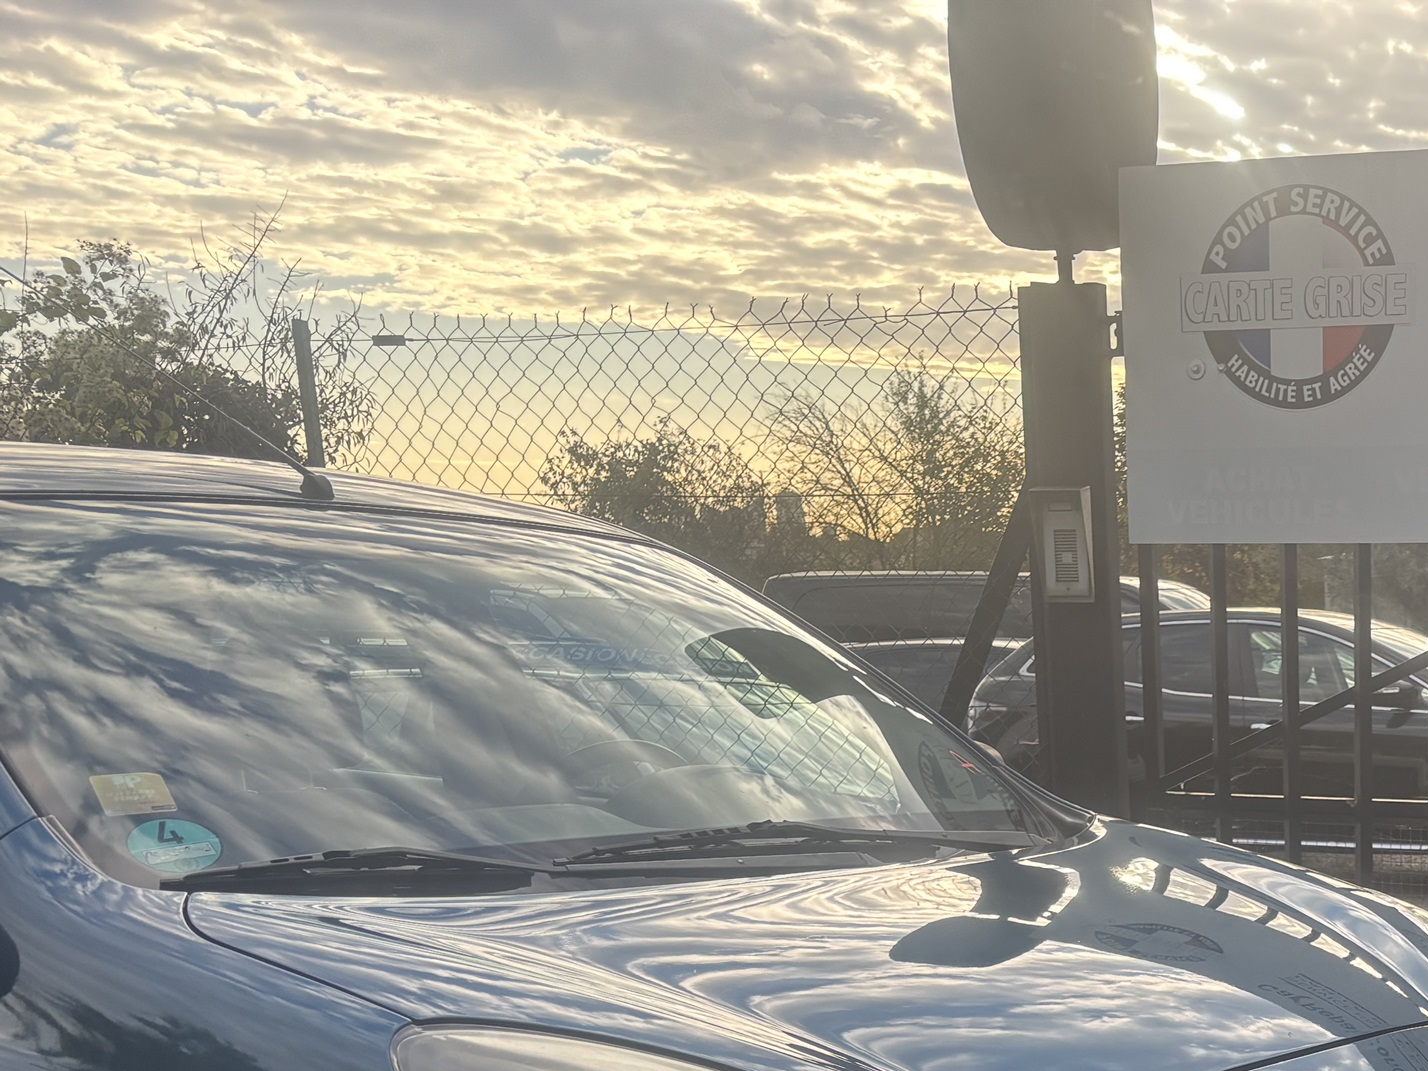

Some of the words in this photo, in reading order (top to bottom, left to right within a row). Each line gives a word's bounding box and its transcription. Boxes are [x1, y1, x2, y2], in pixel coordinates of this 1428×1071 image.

[1208, 192, 1280, 270] POINT
[1289, 186, 1389, 266] SERVICE
[1183, 276, 1295, 324] CARTE
[1303, 271, 1409, 322] GRISE
[1225, 351, 1298, 405] HABILITÉ
[1302, 380, 1324, 404] ET
[1329, 342, 1377, 396] AGRÉÉ
[157, 820, 185, 844] 4
